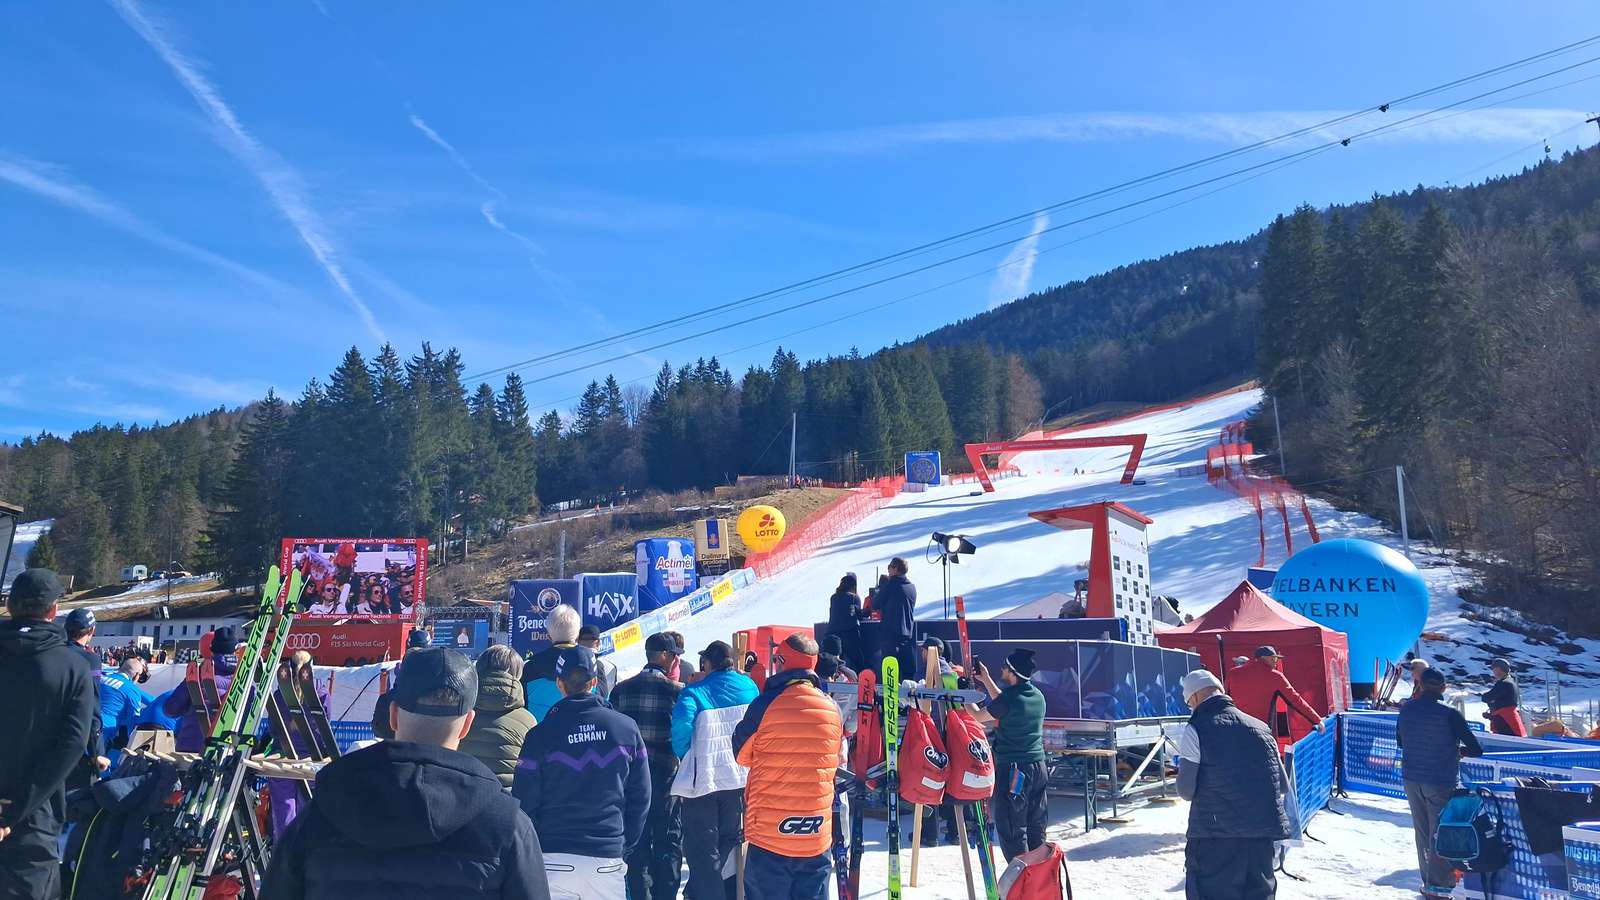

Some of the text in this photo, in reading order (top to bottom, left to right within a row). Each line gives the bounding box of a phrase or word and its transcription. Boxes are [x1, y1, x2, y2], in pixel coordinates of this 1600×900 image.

[755, 529, 779, 537] LOTTO
[656, 556, 694, 569] Actimel
[1275, 577, 1396, 593] IELBANKEN
[372, 641, 385, 649] Cup
[887, 665, 895, 737] FISCHER
[908, 691, 966, 704] HEAD
[579, 724, 596, 732] TEAM
[568, 730, 607, 744] GERMANY
[778, 815, 824, 836] GER
